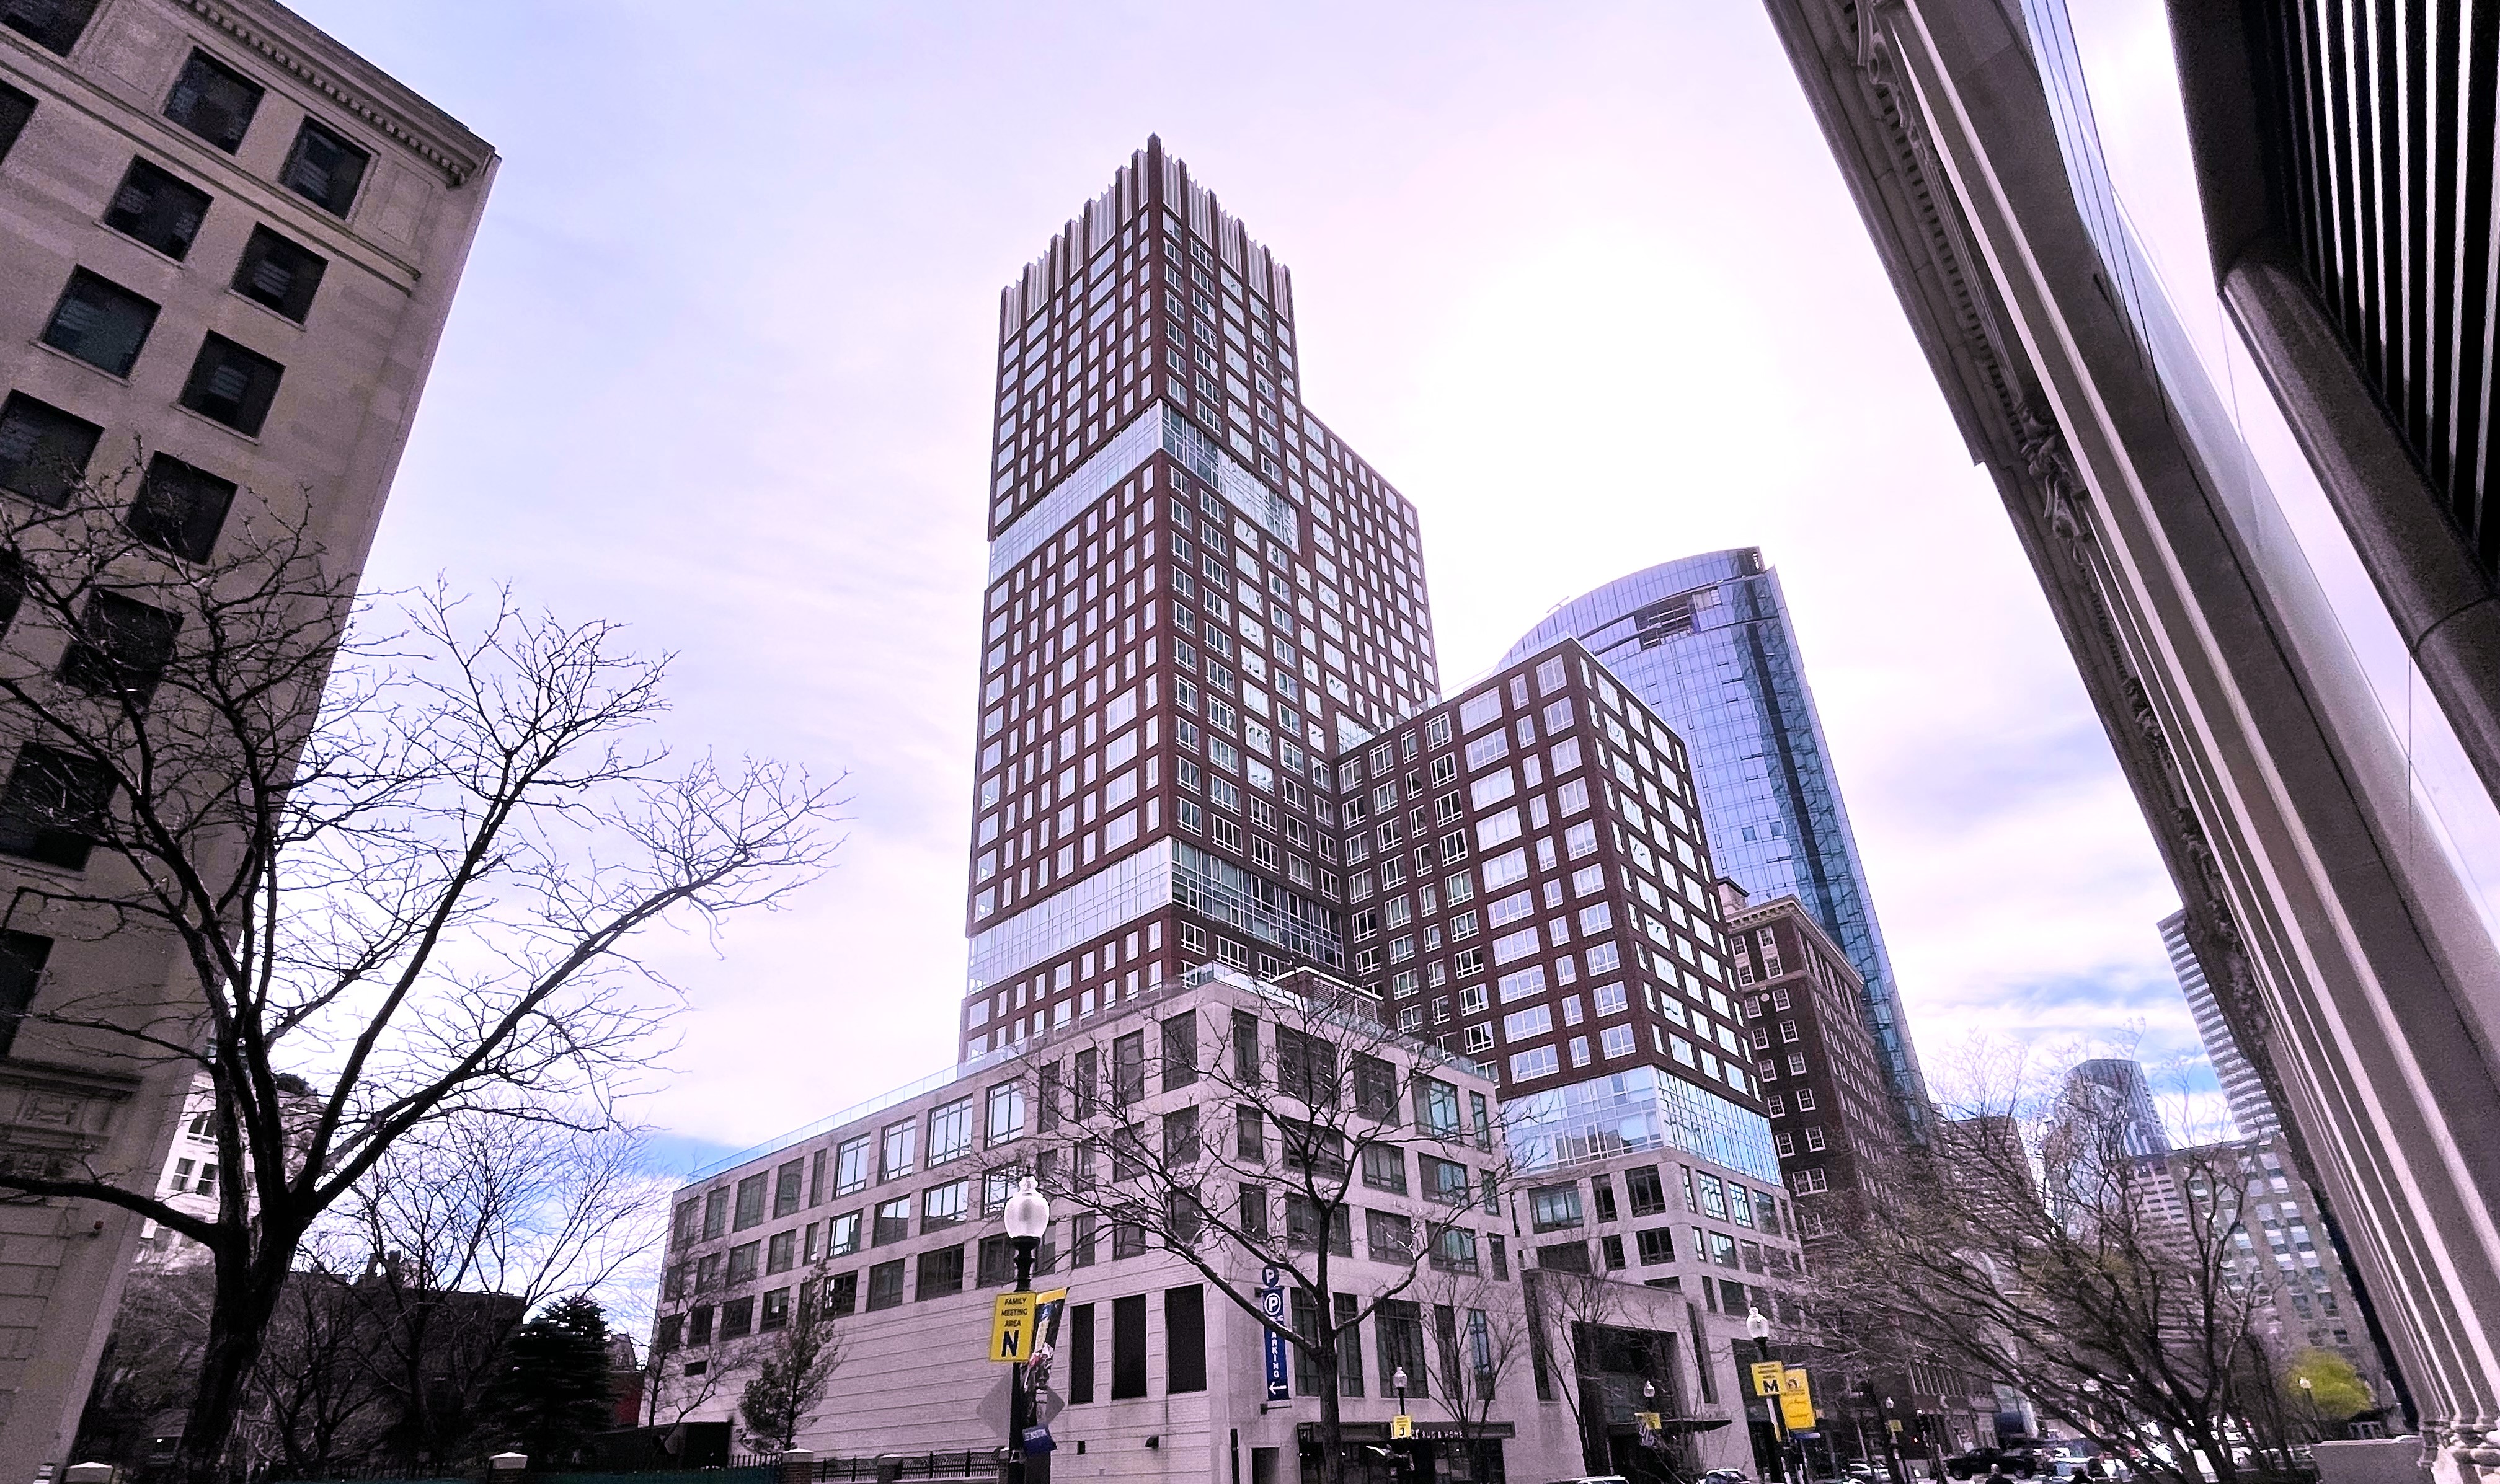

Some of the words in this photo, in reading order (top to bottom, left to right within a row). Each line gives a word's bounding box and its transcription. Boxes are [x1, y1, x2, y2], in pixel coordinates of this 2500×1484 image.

[1266, 1268, 1275, 1284] P
[1005, 1297, 1027, 1305] FAMILY
[1269, 1296, 1279, 1312] P
[1001, 1308, 1027, 1316] MEETING
[1001, 1330, 1019, 1357] N
[1272, 1332, 1280, 1378] ARKING
[1763, 1379, 1779, 1393] M
